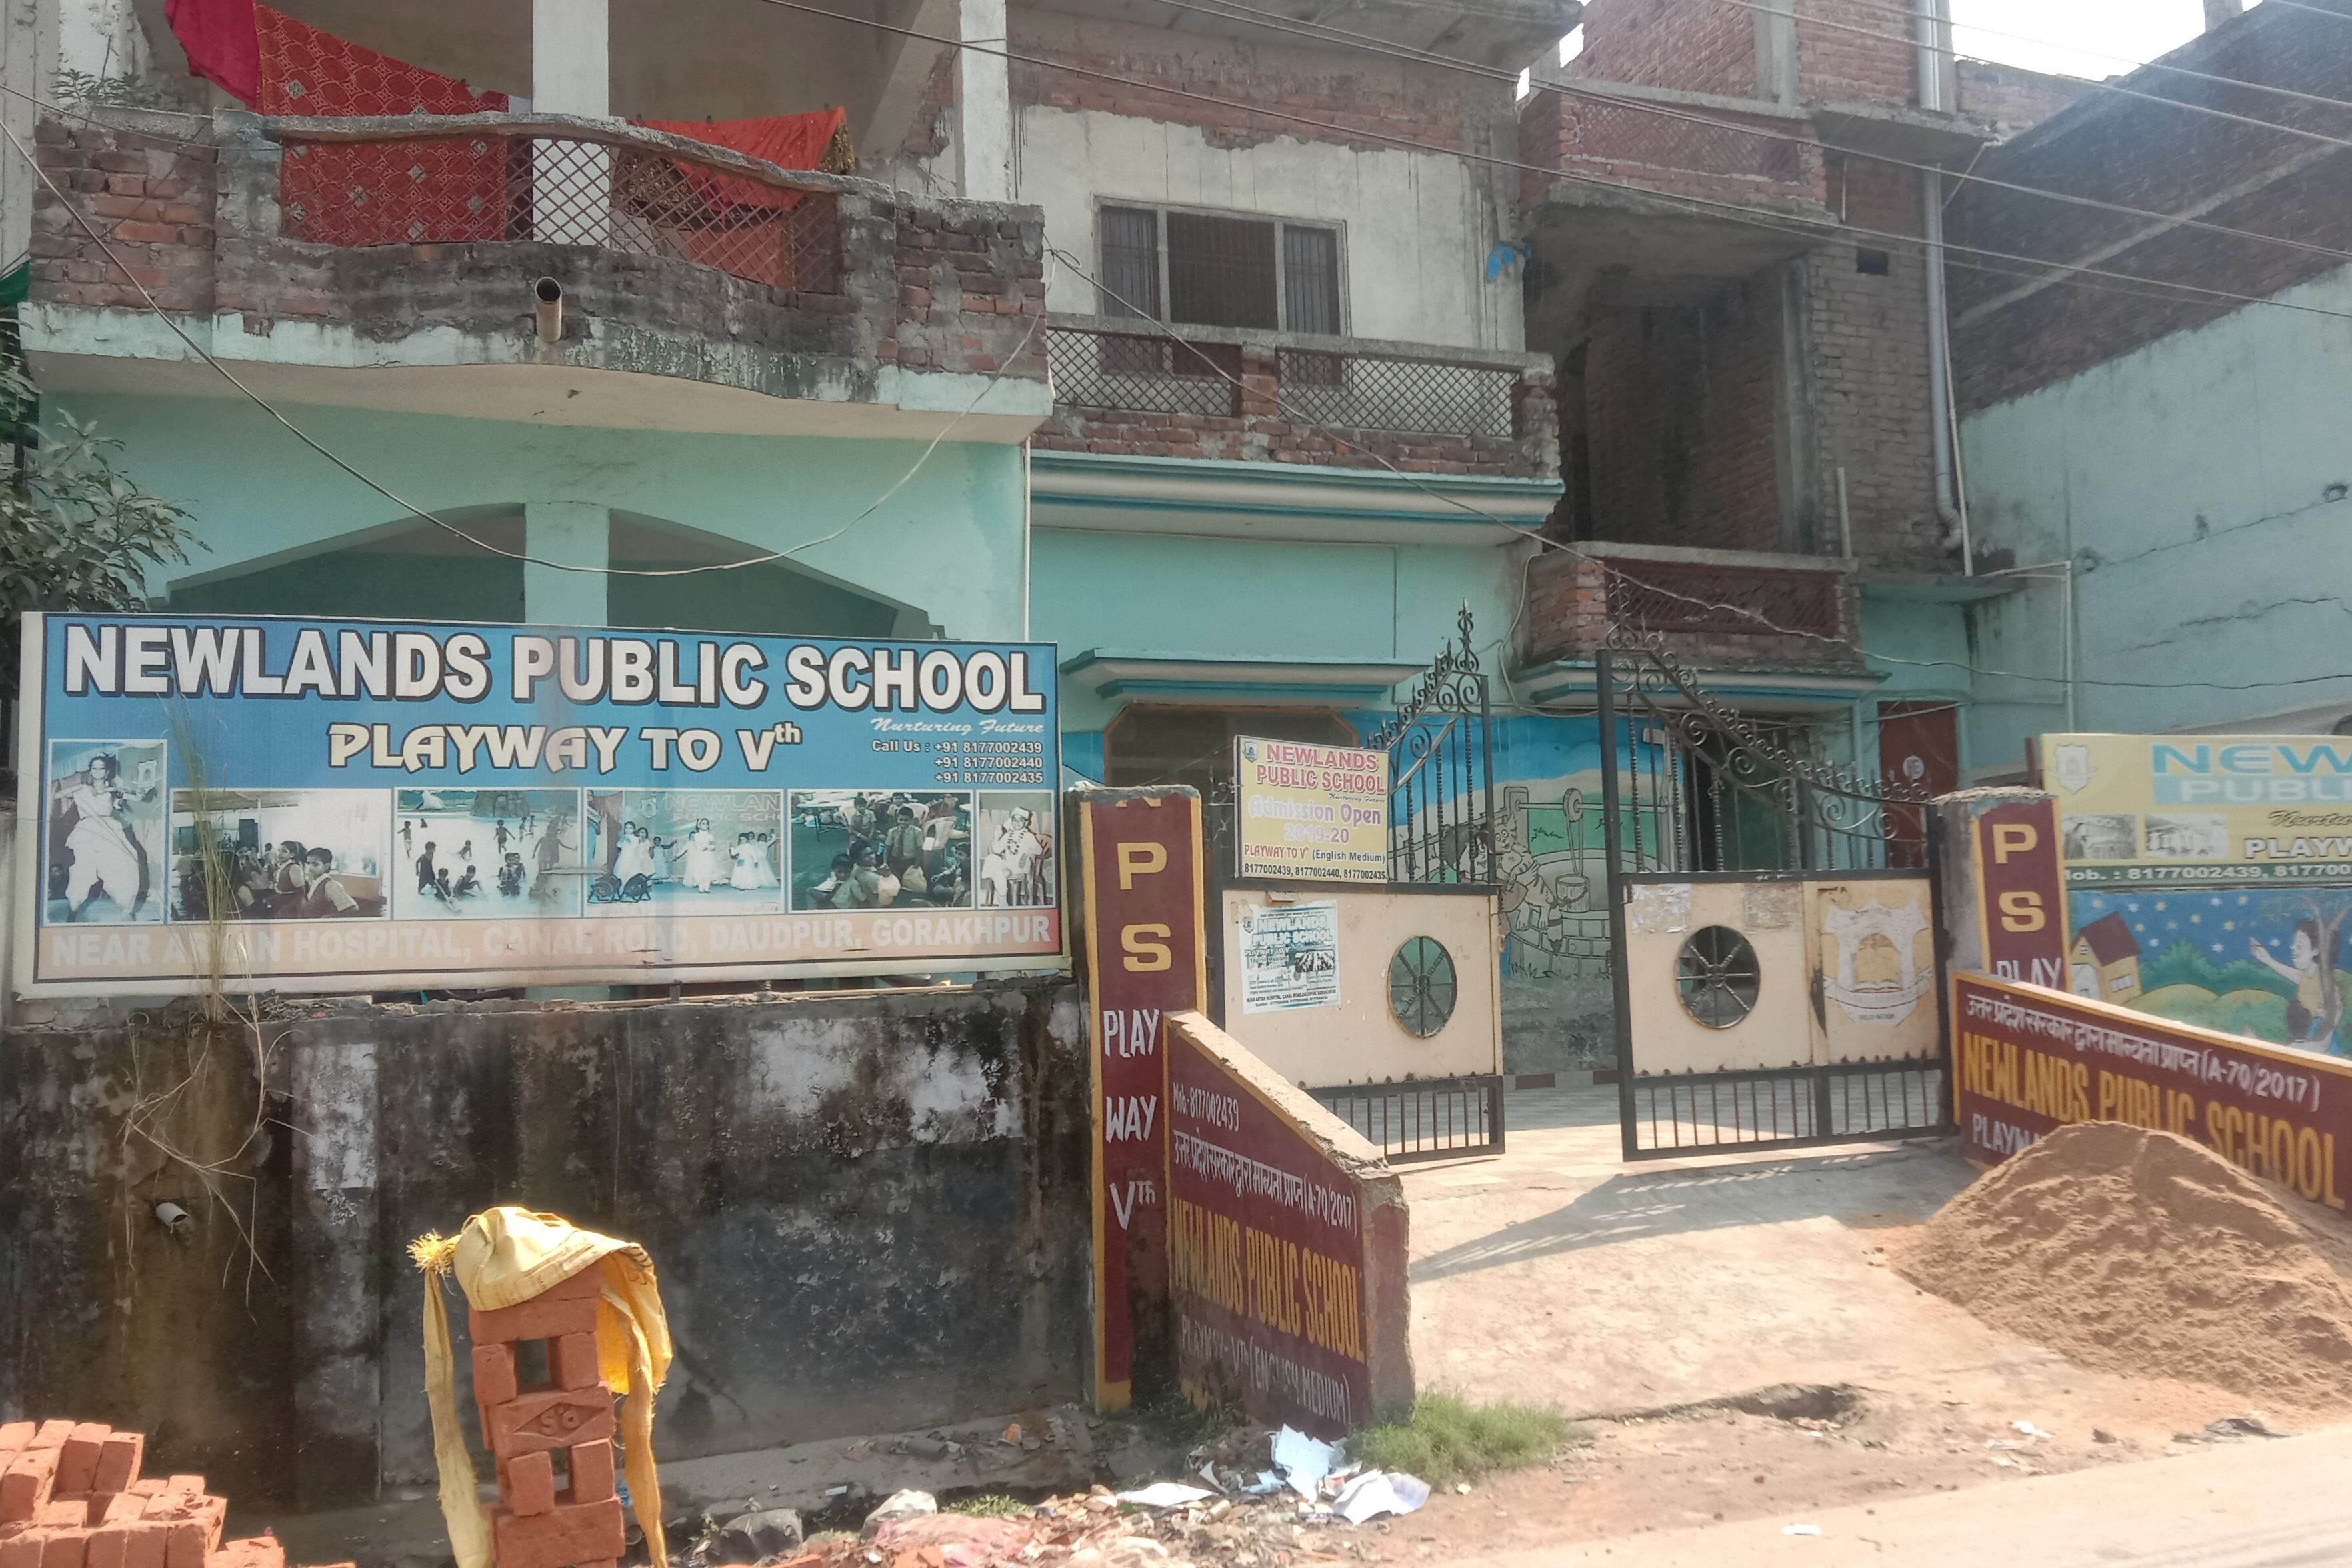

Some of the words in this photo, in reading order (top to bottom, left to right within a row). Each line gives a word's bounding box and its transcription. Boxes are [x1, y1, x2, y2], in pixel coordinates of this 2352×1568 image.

[63, 624, 492, 703] NEWLANDS
[511, 634, 769, 708] PUBLIC
[785, 645, 1047, 714] SCHOOL
[870, 717, 974, 735] Nurturing
[979, 719, 1045, 735] Future
[327, 723, 628, 775] PLAYWAY
[638, 727, 722, 773] TO
[871, 739, 898, 753] Call
[903, 740, 921, 753] Us
[934, 741, 959, 754] +91
[963, 741, 1043, 754] 8177002439
[1266, 743, 1380, 772] NEWLANDS
[2152, 743, 2352, 773] NEW
[934, 756, 959, 769] +91
[963, 756, 1043, 769] 8177002440
[934, 771, 959, 784] +91
[963, 771, 1044, 784] 8177002435
[1256, 764, 1318, 789] PUBLIC
[1321, 771, 1387, 795] SCHOOL
[1339, 802, 1382, 829] Open
[1283, 822, 1351, 845] 2019-20
[1244, 844, 1284, 859] PLAYWAY
[1286, 847, 1297, 860] TO
[1312, 849, 1347, 862] (English
[1349, 851, 1385, 863] Medium)
[1244, 863, 1293, 877] 8177002439,
[1295, 866, 1341, 880] 8177002440,
[1343, 869, 1386, 880] 8177002435
[2127, 866, 2269, 881] 8177002439,
[2274, 863, 2352, 878] 817700
[52, 933, 151, 967] NEAR
[295, 927, 471, 964] HOSPITAL,
[483, 924, 593, 956] CANAL
[872, 915, 1051, 946] GORAKHPUR
[1103, 1008, 1159, 1058] PLAY
[1106, 1095, 1157, 1144] WAY
[1964, 1031, 2092, 1124] NEWLANDS
[2207, 1101, 2345, 1211] SCHOOL
[1173, 1197, 1243, 1316] NEWLANDS
[1246, 1226, 1300, 1337] PUBLIC
[1303, 1247, 1366, 1365] SCHOOL
